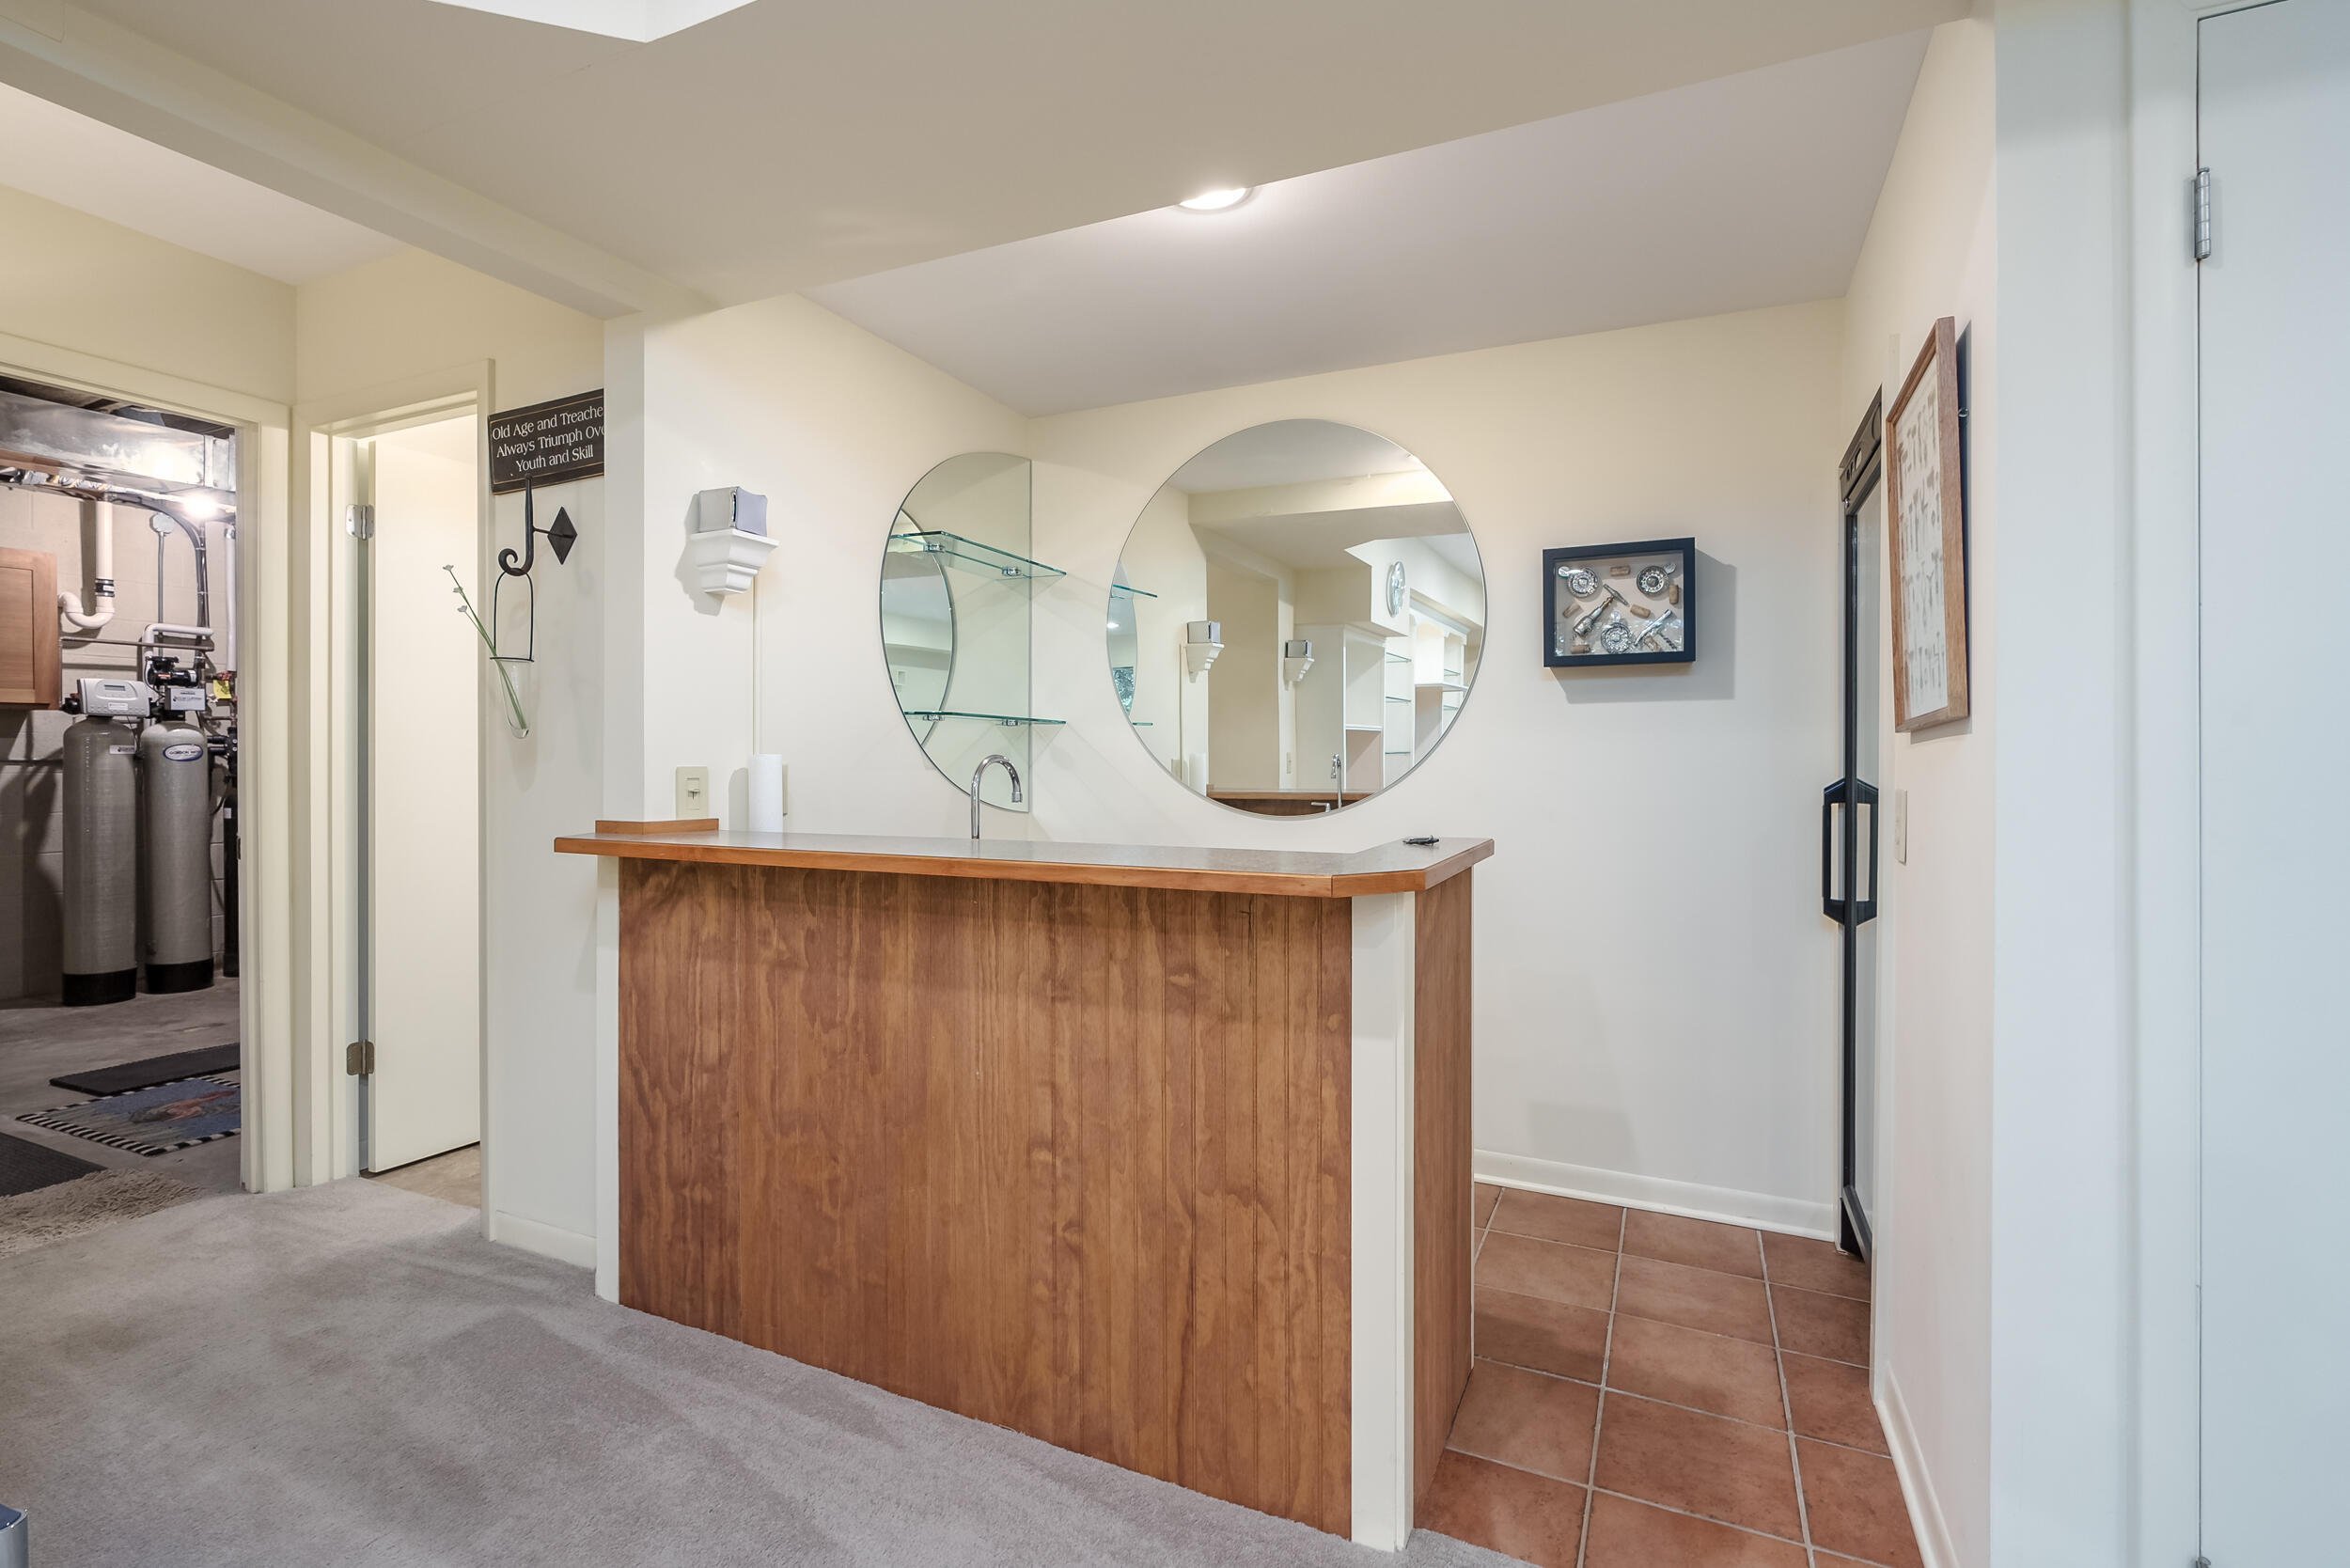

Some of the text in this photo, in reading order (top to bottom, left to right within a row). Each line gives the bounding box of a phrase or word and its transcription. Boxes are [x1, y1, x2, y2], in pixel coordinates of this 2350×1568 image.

[492, 425, 510, 440] Old
[513, 422, 534, 437] Age
[537, 415, 557, 429] and
[496, 440, 536, 458] Always
[538, 428, 583, 449] Triumph
[516, 444, 594, 472] Youth and Skill
